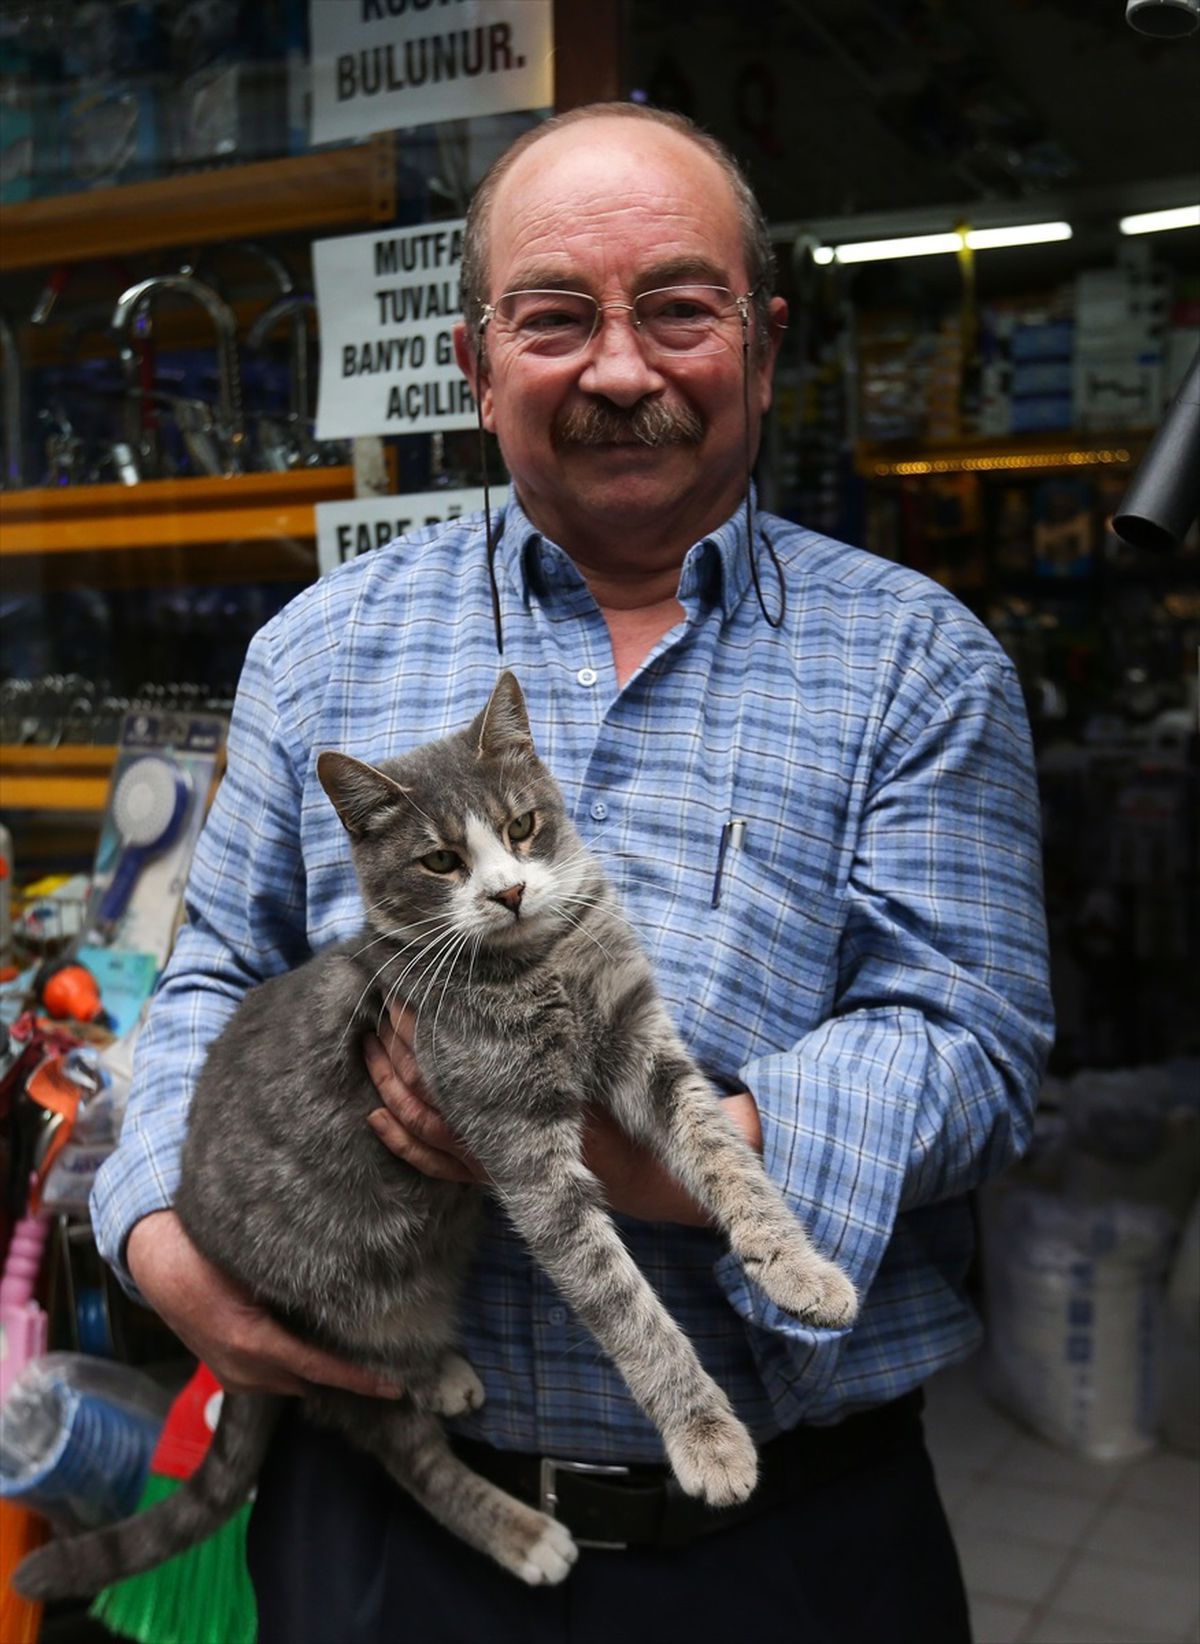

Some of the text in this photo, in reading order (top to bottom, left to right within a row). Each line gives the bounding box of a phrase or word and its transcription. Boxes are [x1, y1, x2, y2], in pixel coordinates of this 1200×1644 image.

[336, 21, 526, 102] BULUNUR.
[342, 335, 426, 378] BANYO
[386, 380, 476, 424] AÇILIR
